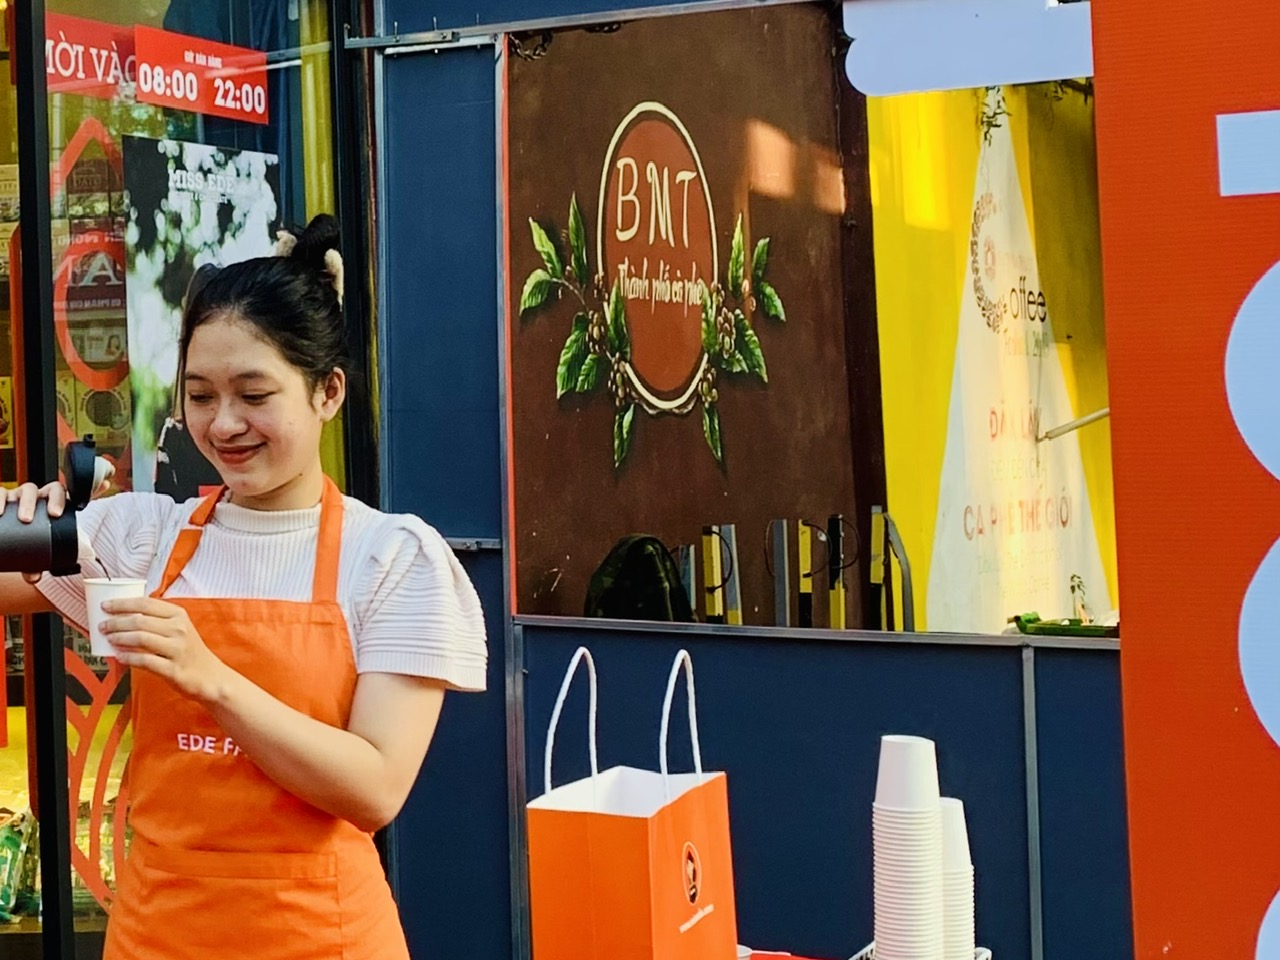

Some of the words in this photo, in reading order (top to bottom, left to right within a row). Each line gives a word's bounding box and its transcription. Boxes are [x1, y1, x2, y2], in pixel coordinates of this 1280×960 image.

[138, 62, 198, 101] 08:00
[214, 77, 266, 114] 22:00
[616, 157, 698, 249] BMT
[177, 733, 217, 754] EDE
